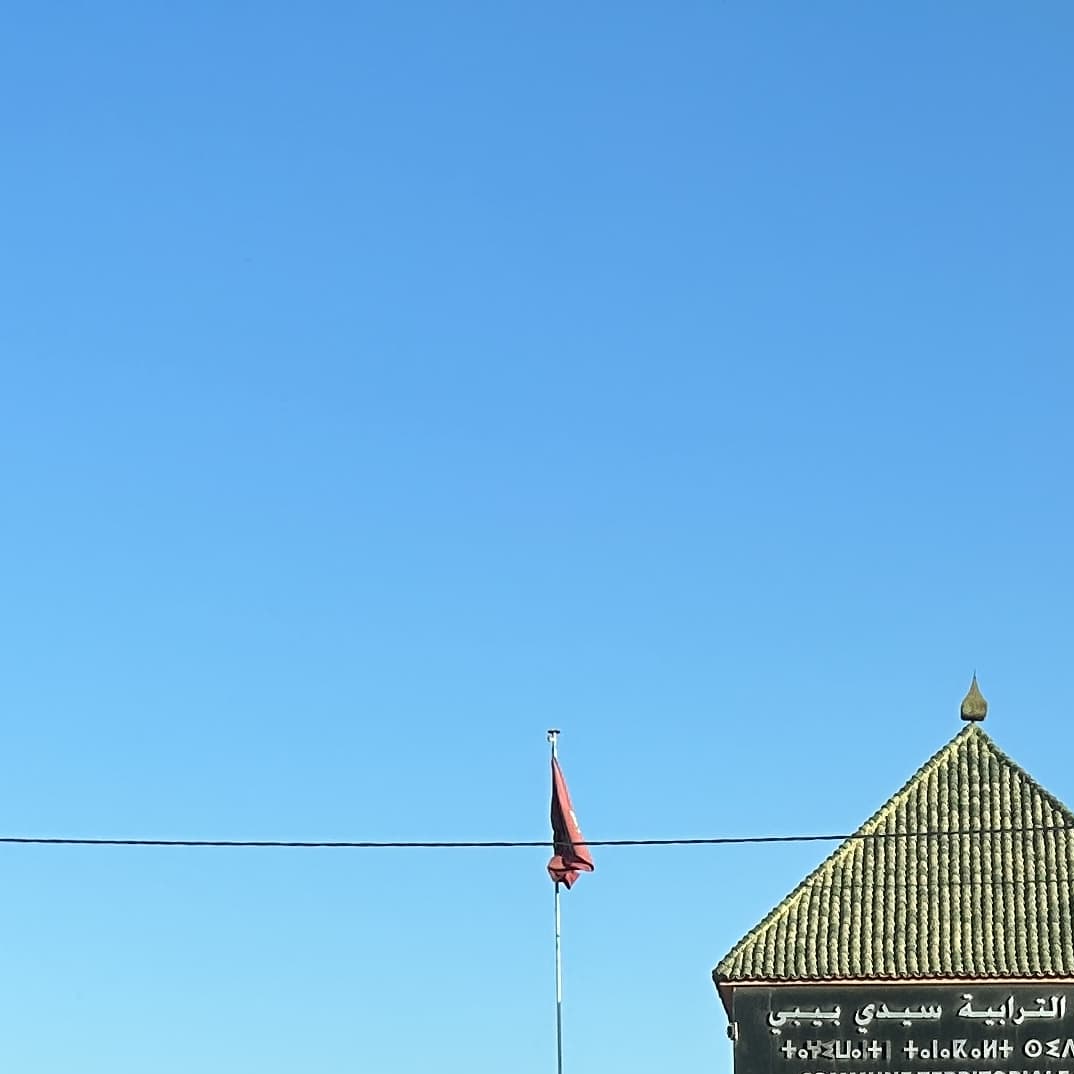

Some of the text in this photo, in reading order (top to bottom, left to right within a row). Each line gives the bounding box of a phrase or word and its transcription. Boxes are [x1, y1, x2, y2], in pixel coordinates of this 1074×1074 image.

[767, 1003, 841, 1034] بيبي
[854, 1001, 942, 1033] سيدي
[958, 994, 1066, 1026] الترابية
